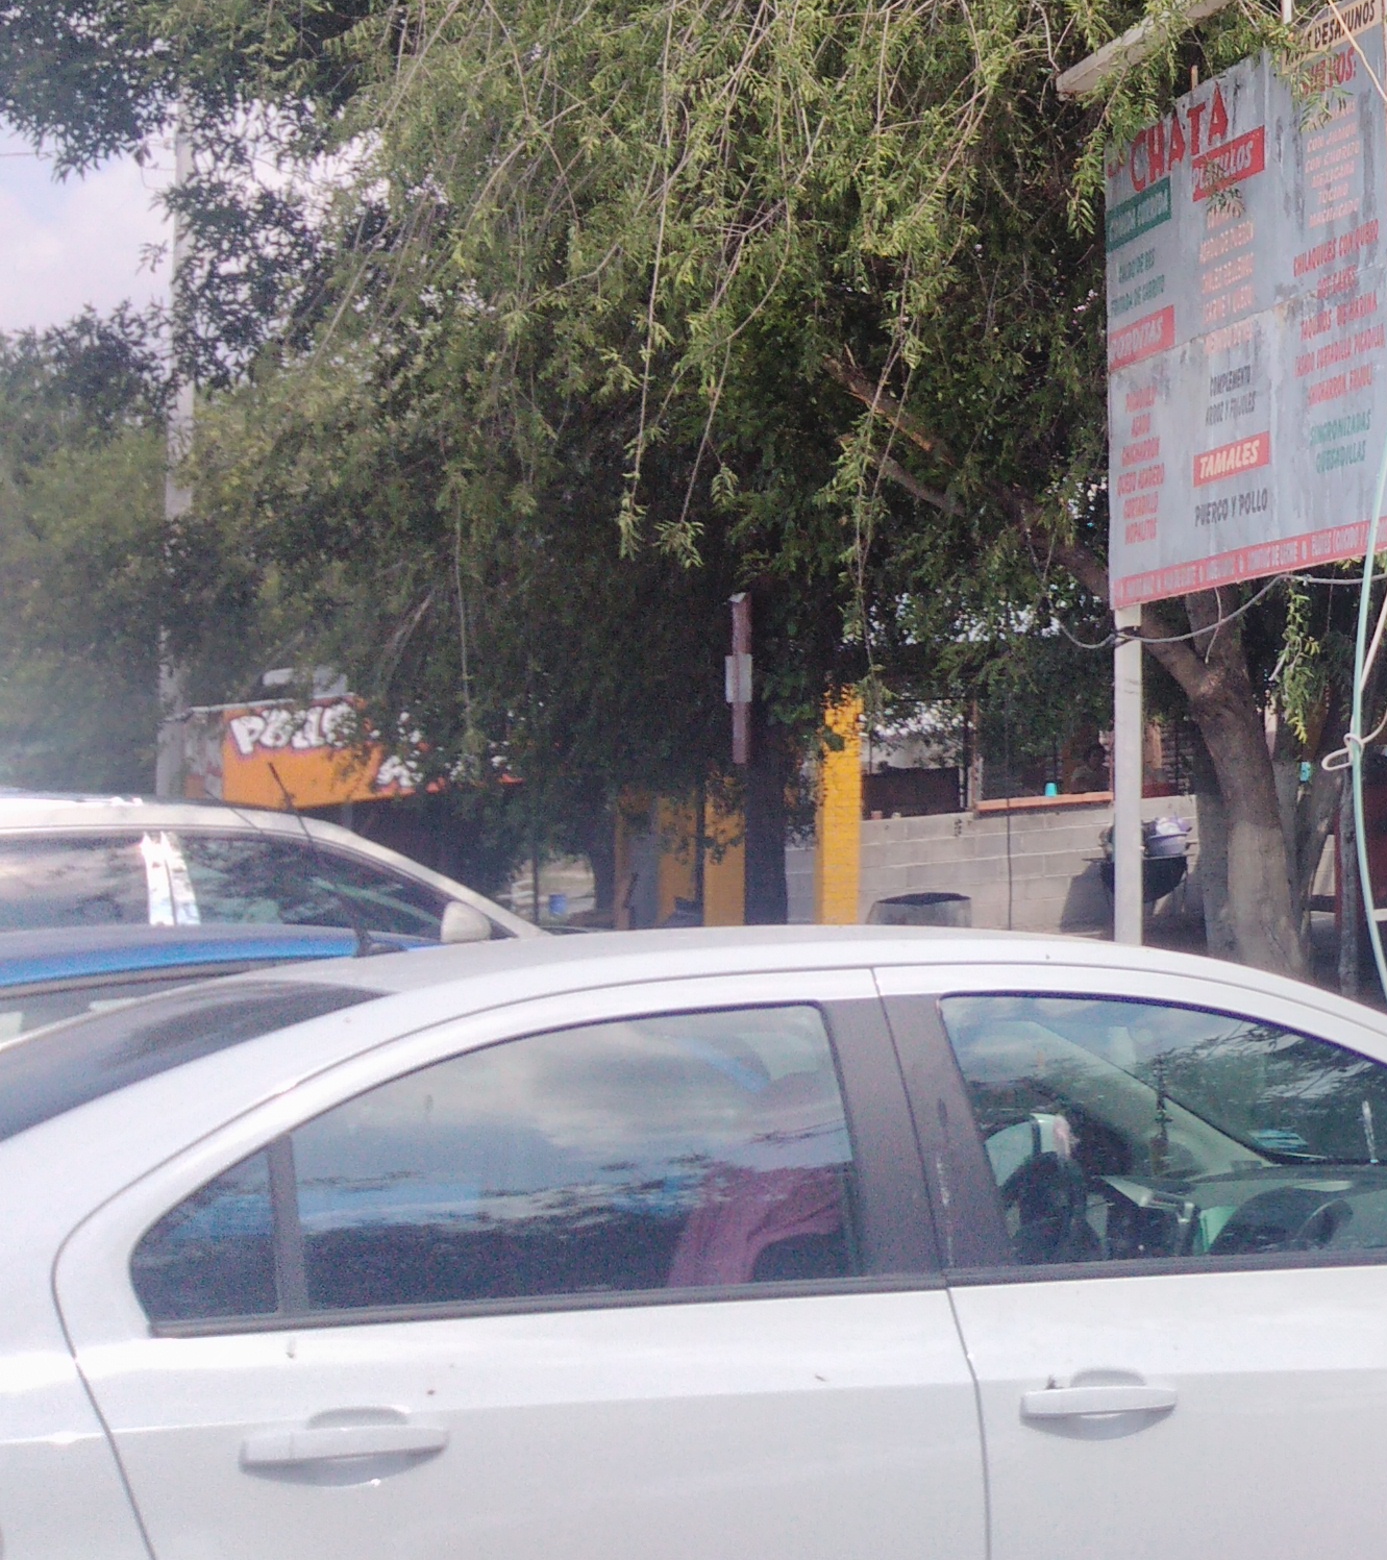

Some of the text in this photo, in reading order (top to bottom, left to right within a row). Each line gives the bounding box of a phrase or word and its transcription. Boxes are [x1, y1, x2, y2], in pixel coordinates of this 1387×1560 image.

[1130, 80, 1229, 192] CHATA
[1200, 439, 1260, 480] TAMALES
[1194, 488, 1268, 527] PUERCO Y POLLO
